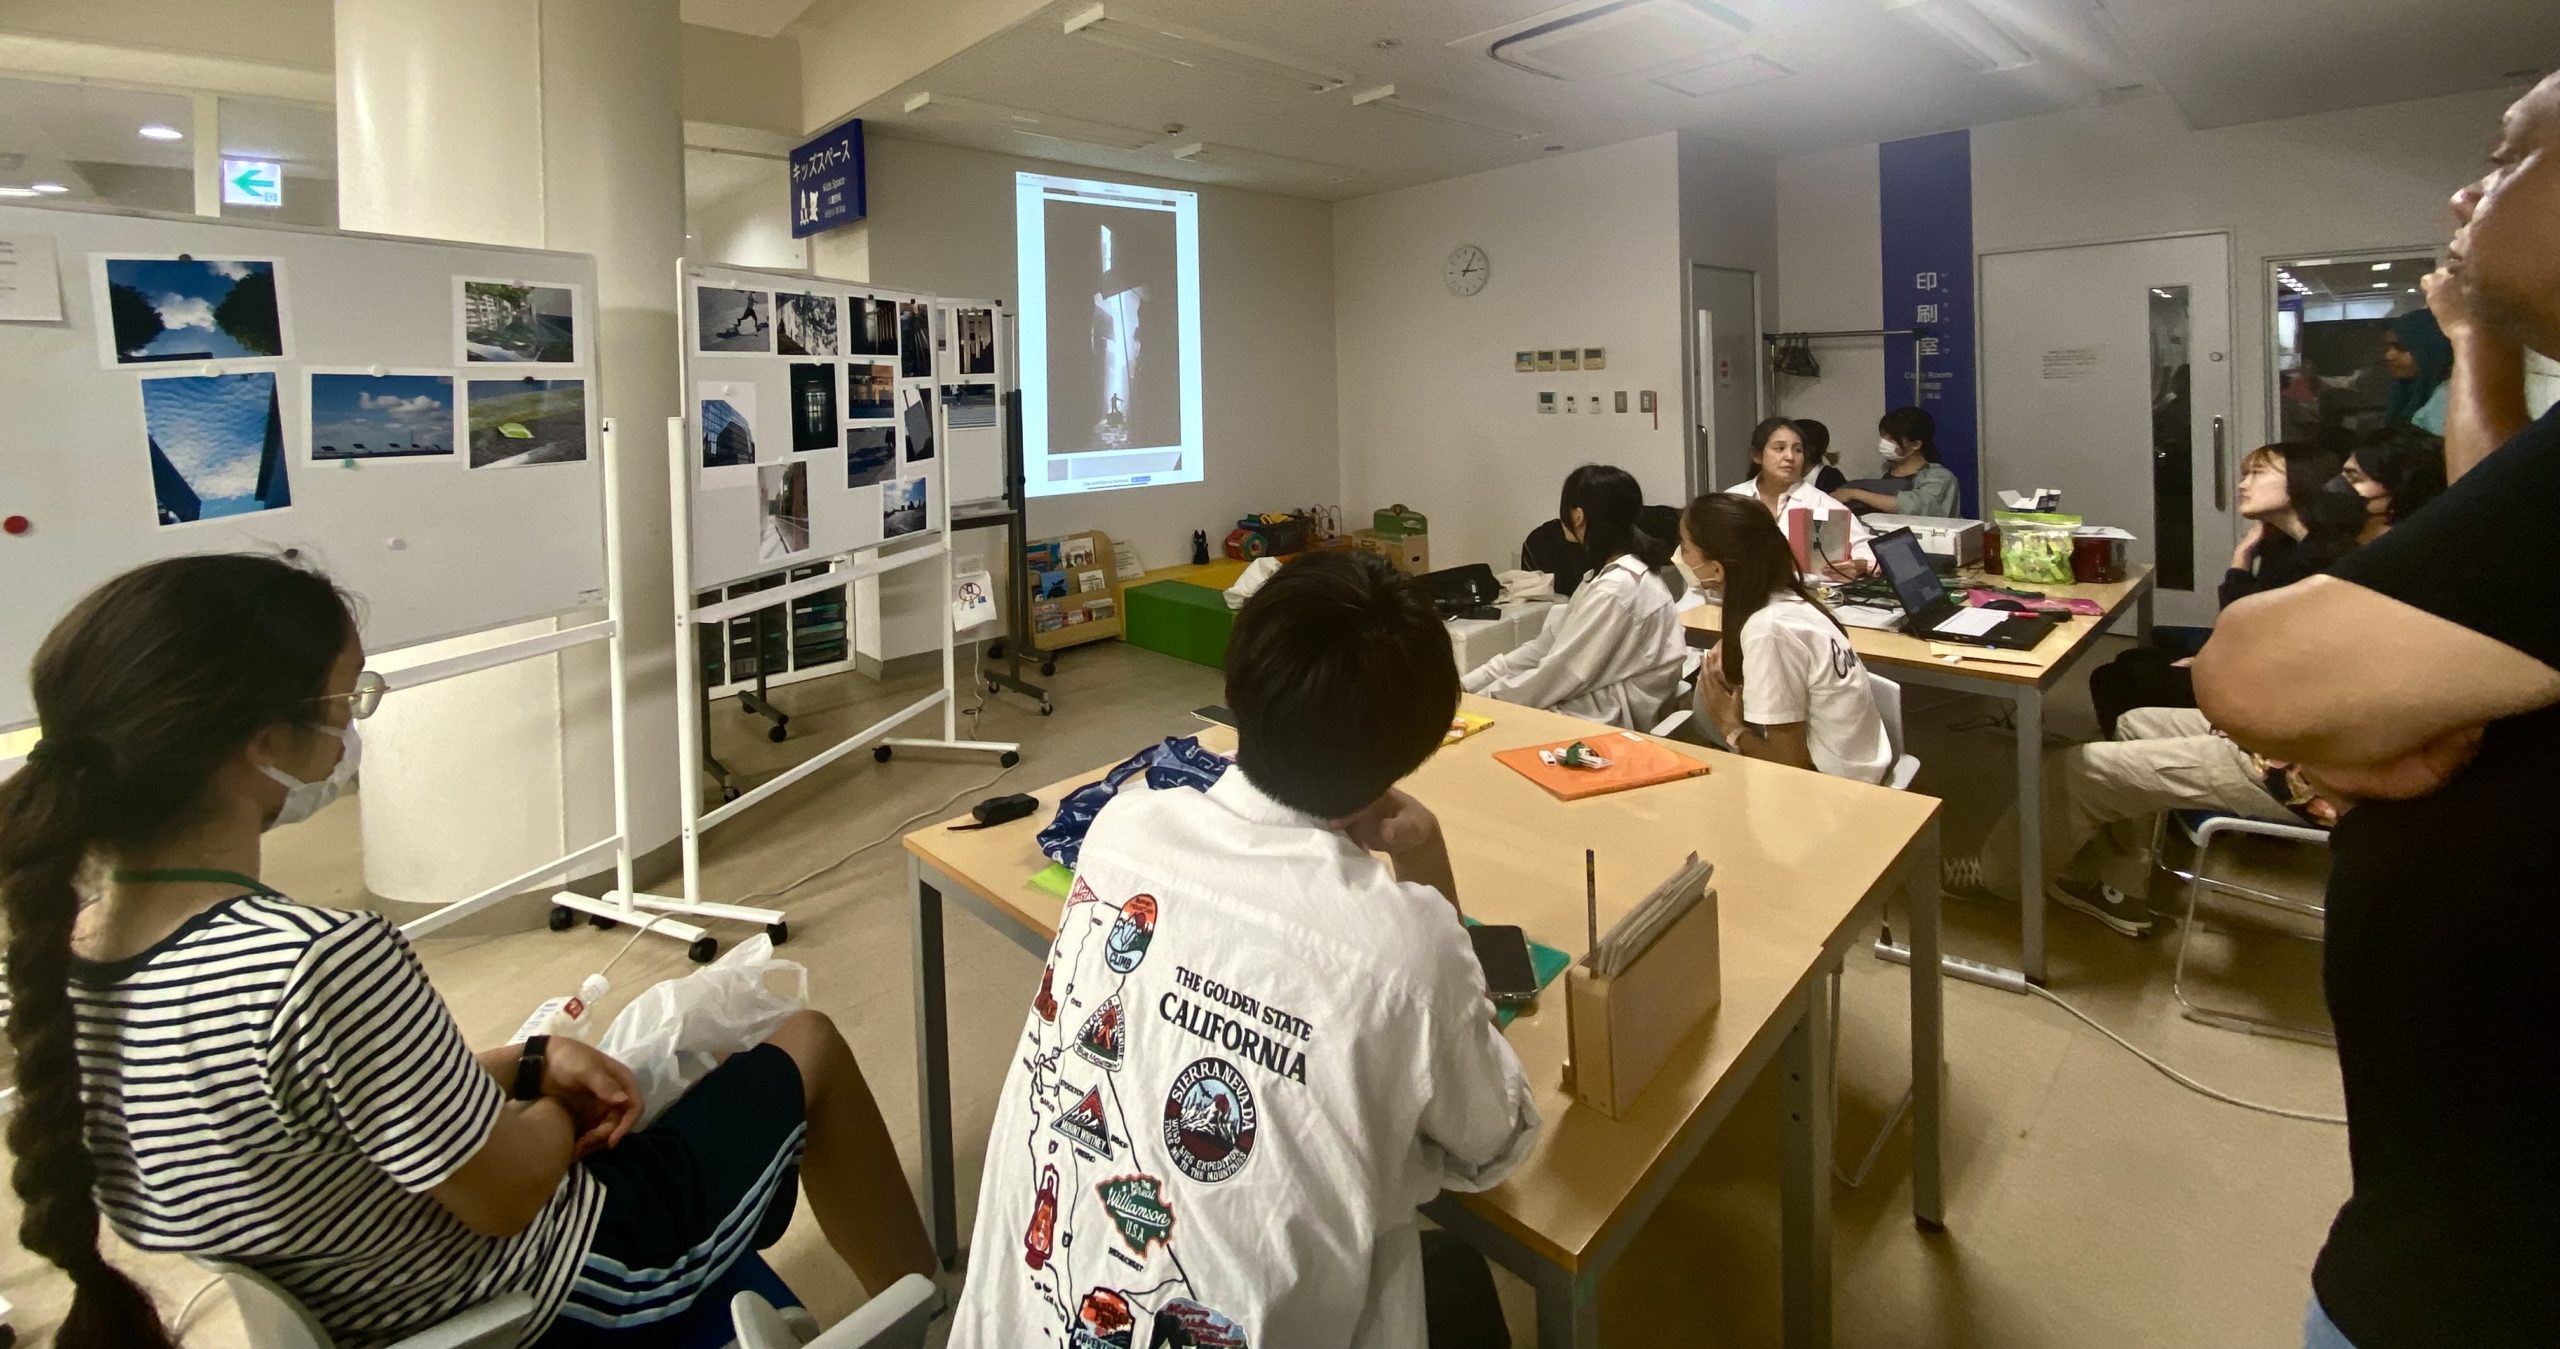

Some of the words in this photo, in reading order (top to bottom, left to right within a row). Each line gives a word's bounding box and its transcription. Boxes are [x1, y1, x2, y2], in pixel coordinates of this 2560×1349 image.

[793, 140, 850, 184] キッズスペース
[1916, 271, 1939, 356] 印刷室
[1109, 951, 1132, 970] CLIMB
[1176, 966, 1202, 992] THE
[1203, 979, 1260, 1019] GOLDEN
[1262, 1006, 1313, 1042] STATE
[1159, 992, 1306, 1086] CALIFORNIA
[1172, 1061, 1220, 1104] SIERRA
[1221, 1064, 1255, 1132] NEVADA
[1060, 1119, 1081, 1139] MOUNT
[1107, 1187, 1171, 1224] Williamson
[1130, 1181, 1156, 1200] Great
